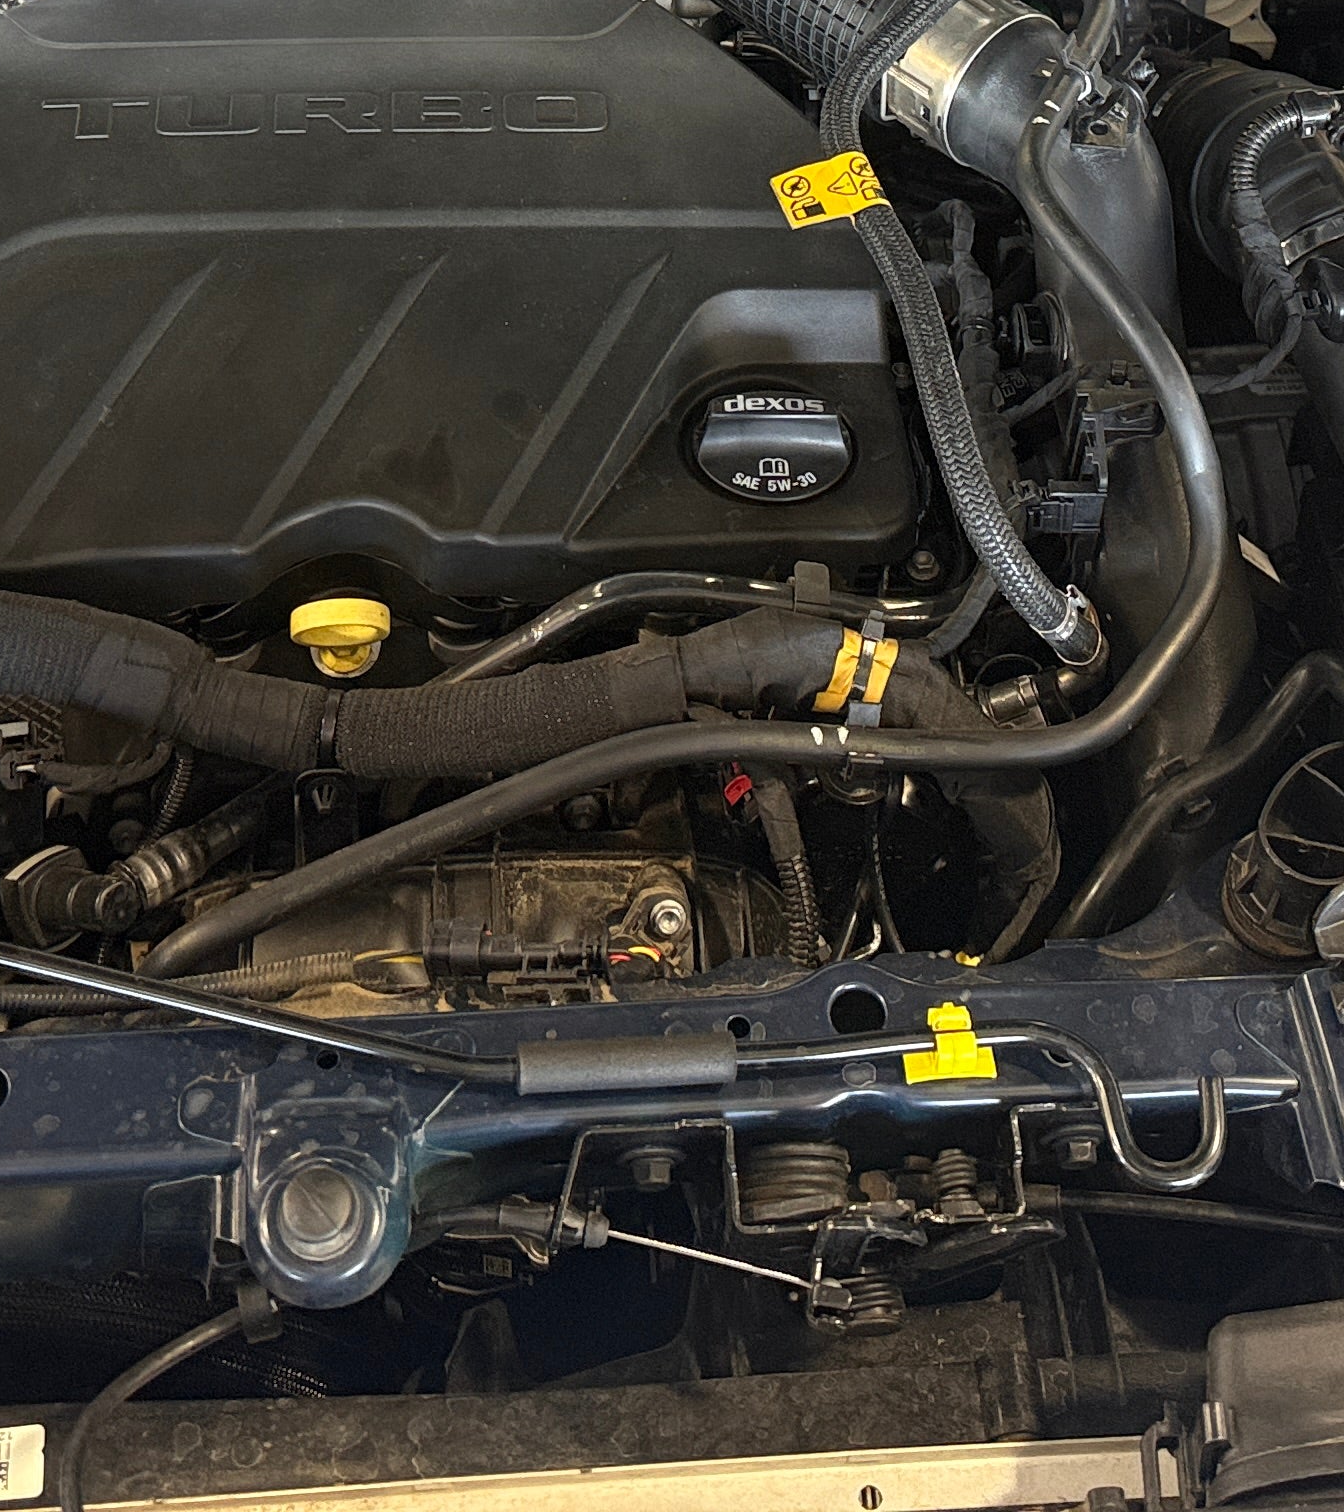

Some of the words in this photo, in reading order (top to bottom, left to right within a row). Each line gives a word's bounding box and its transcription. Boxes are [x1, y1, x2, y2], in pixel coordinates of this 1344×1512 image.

[42, 91, 610, 140] TURBO
[724, 395, 825, 413] dexos
[732, 472, 762, 491] SAE
[767, 471, 817, 493] 5W-30
